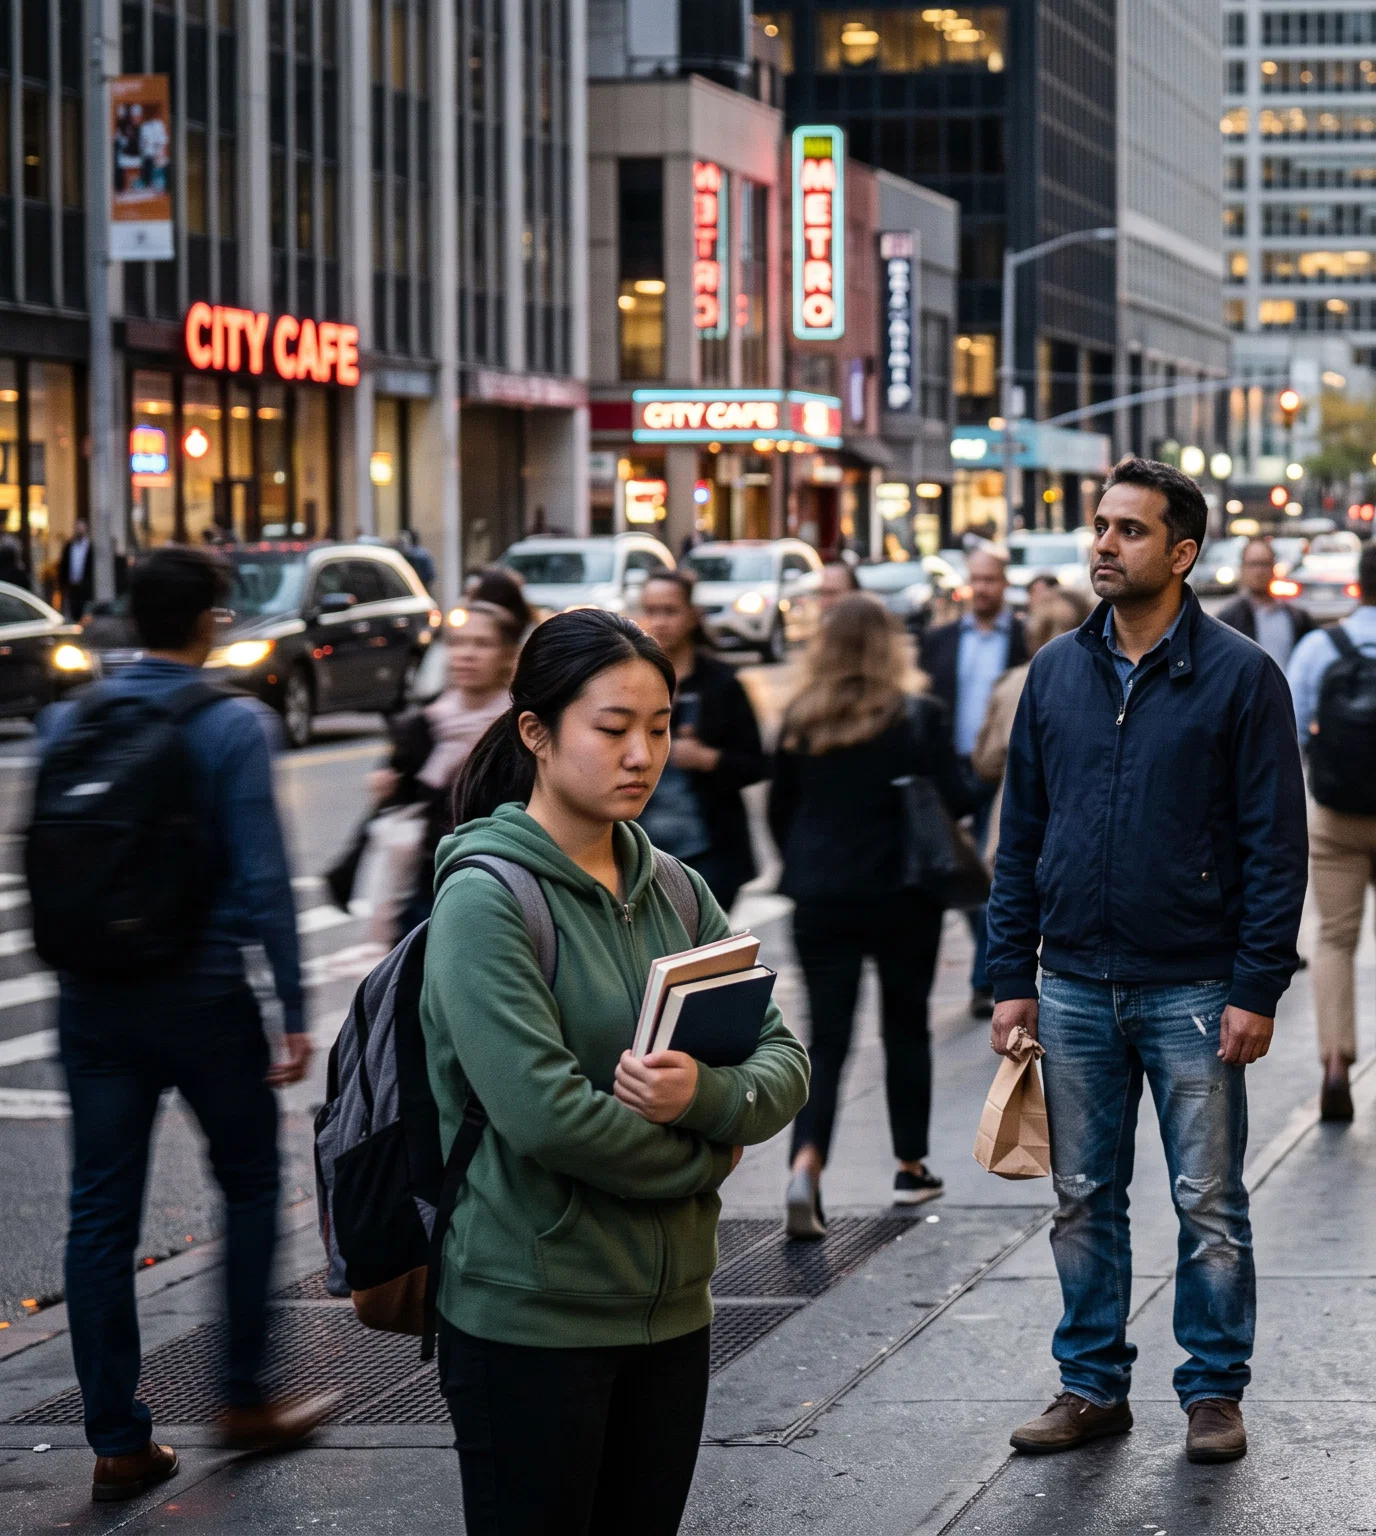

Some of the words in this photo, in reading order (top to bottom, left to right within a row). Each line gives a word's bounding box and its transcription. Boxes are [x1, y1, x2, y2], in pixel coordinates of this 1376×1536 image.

[800, 158, 836, 327] METRO
[185, 301, 269, 375] CITY
[273, 314, 360, 387] CAFE
[643, 402, 706, 429] CITY
